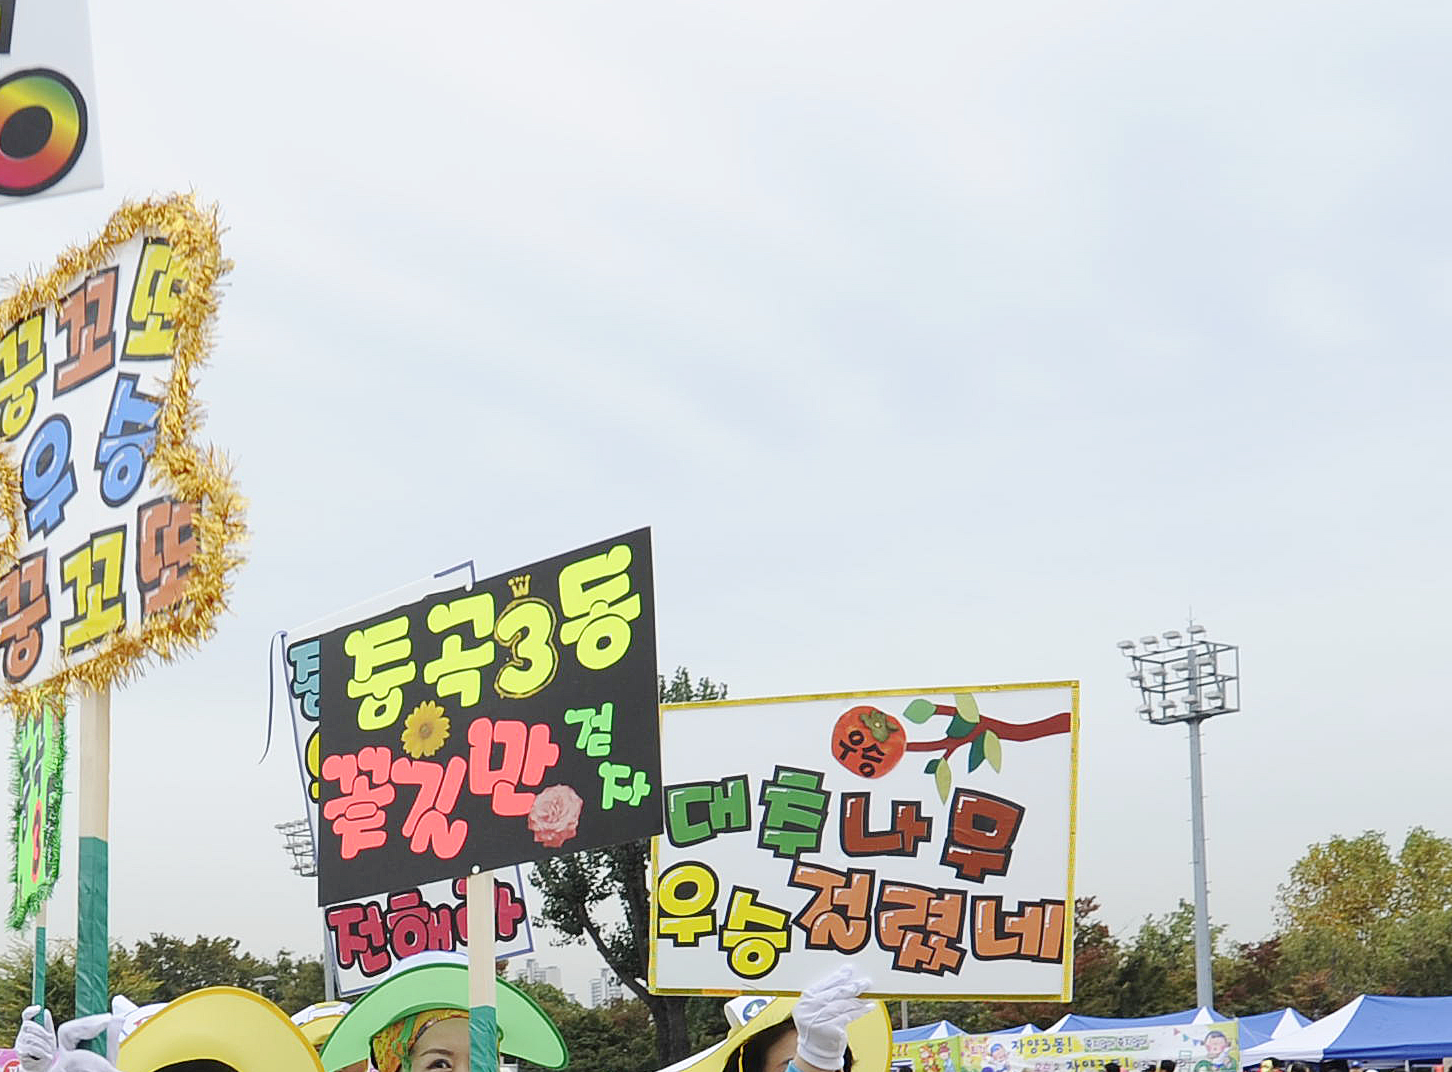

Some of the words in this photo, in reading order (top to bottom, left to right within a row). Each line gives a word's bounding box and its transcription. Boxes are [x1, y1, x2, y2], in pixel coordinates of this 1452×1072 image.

[21, 372, 162, 540] 우승
[344, 544, 642, 731] 중곡3동
[321, 717, 560, 860] 꽃길만
[564, 702, 651, 811] 걷자
[839, 730, 885, 778] 우승
[664, 764, 1026, 884] 대추나무
[657, 860, 793, 980] 우승
[788, 859, 1066, 977] 걸렸네
[1011, 1035, 1073, 1054] 자양3동!
